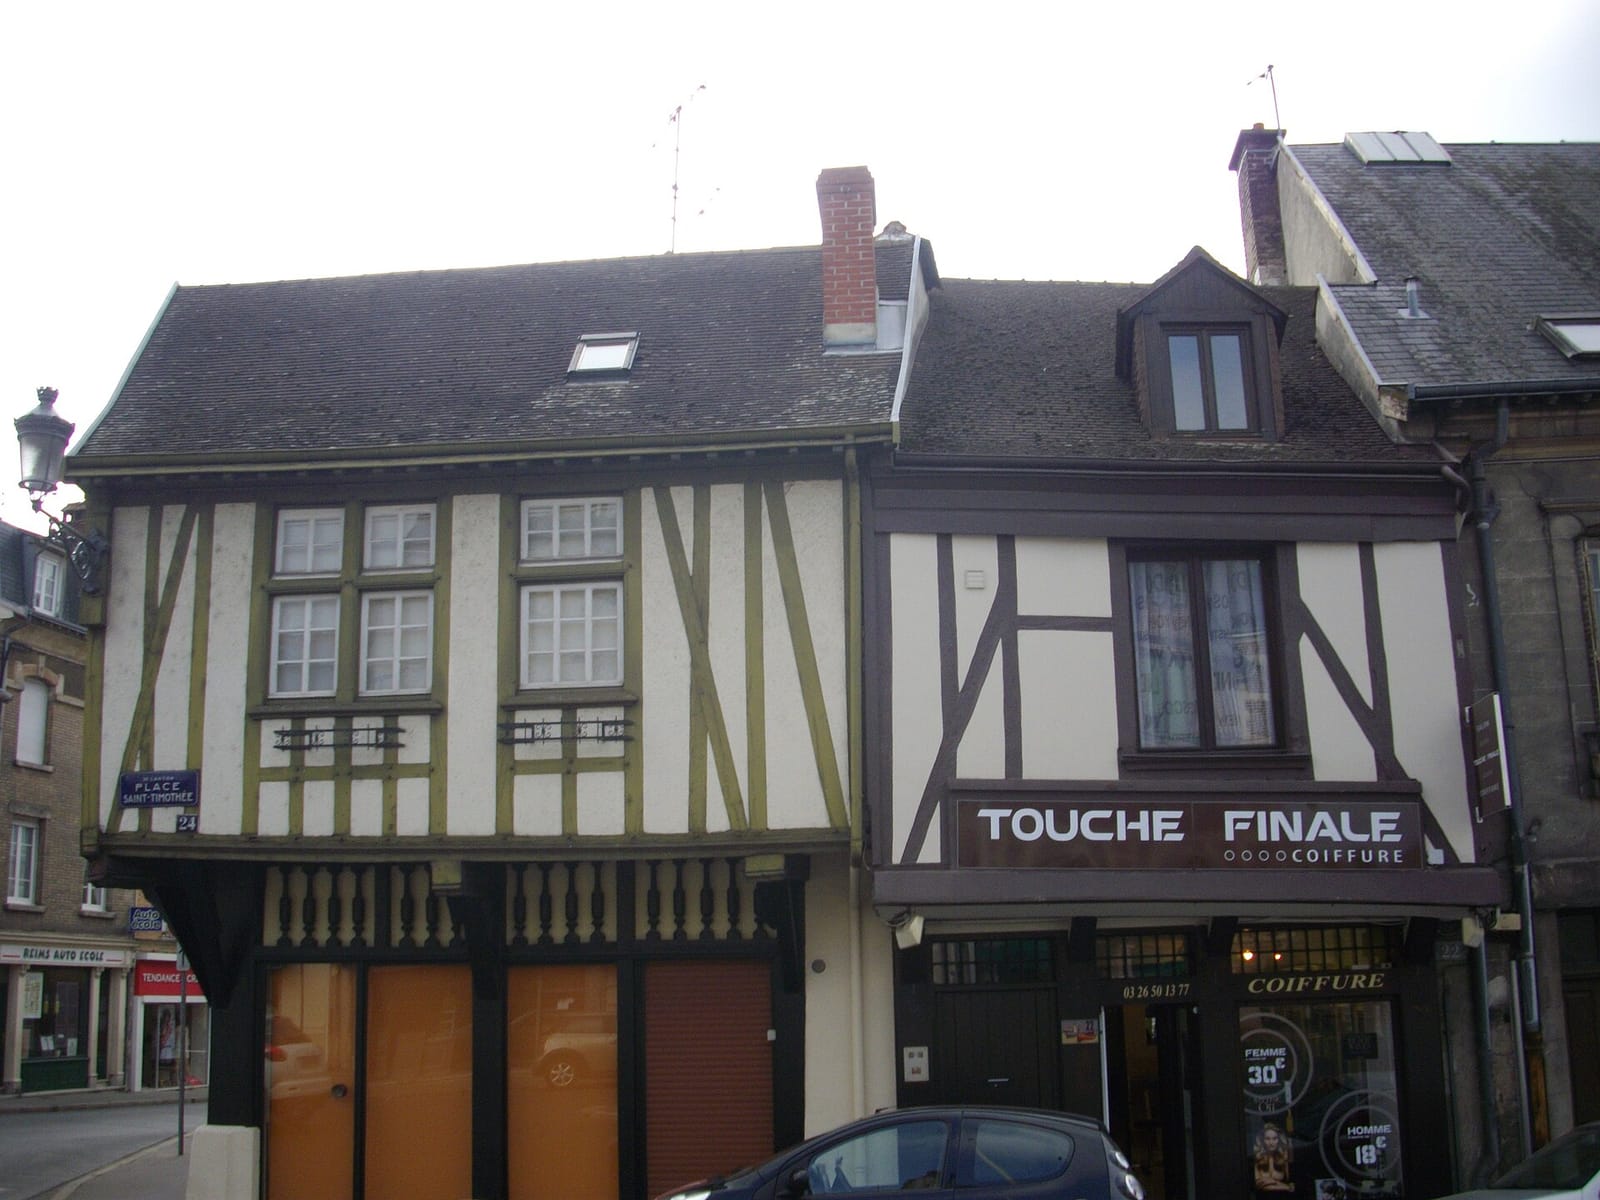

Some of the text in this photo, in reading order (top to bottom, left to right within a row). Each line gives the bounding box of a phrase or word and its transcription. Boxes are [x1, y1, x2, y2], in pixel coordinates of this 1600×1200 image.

[135, 782, 180, 792] PLACE
[123, 790, 194, 803] SAINT-TIMOTHÉE
[179, 816, 196, 830] 24
[977, 808, 1403, 842] TOUCHE FINALE
[1292, 849, 1404, 863] COIFFURE
[133, 909, 160, 919] Auto
[23, 948, 104, 961] REIMS AUTO ECOLE
[143, 973, 180, 983] TENDANCE
[1248, 973, 1385, 994] COIFFURE
[1123, 983, 1190, 999] 03 26 50 13 77
[1245, 1048, 1286, 1058] FEMME
[1347, 1125, 1392, 1136] HOMME
